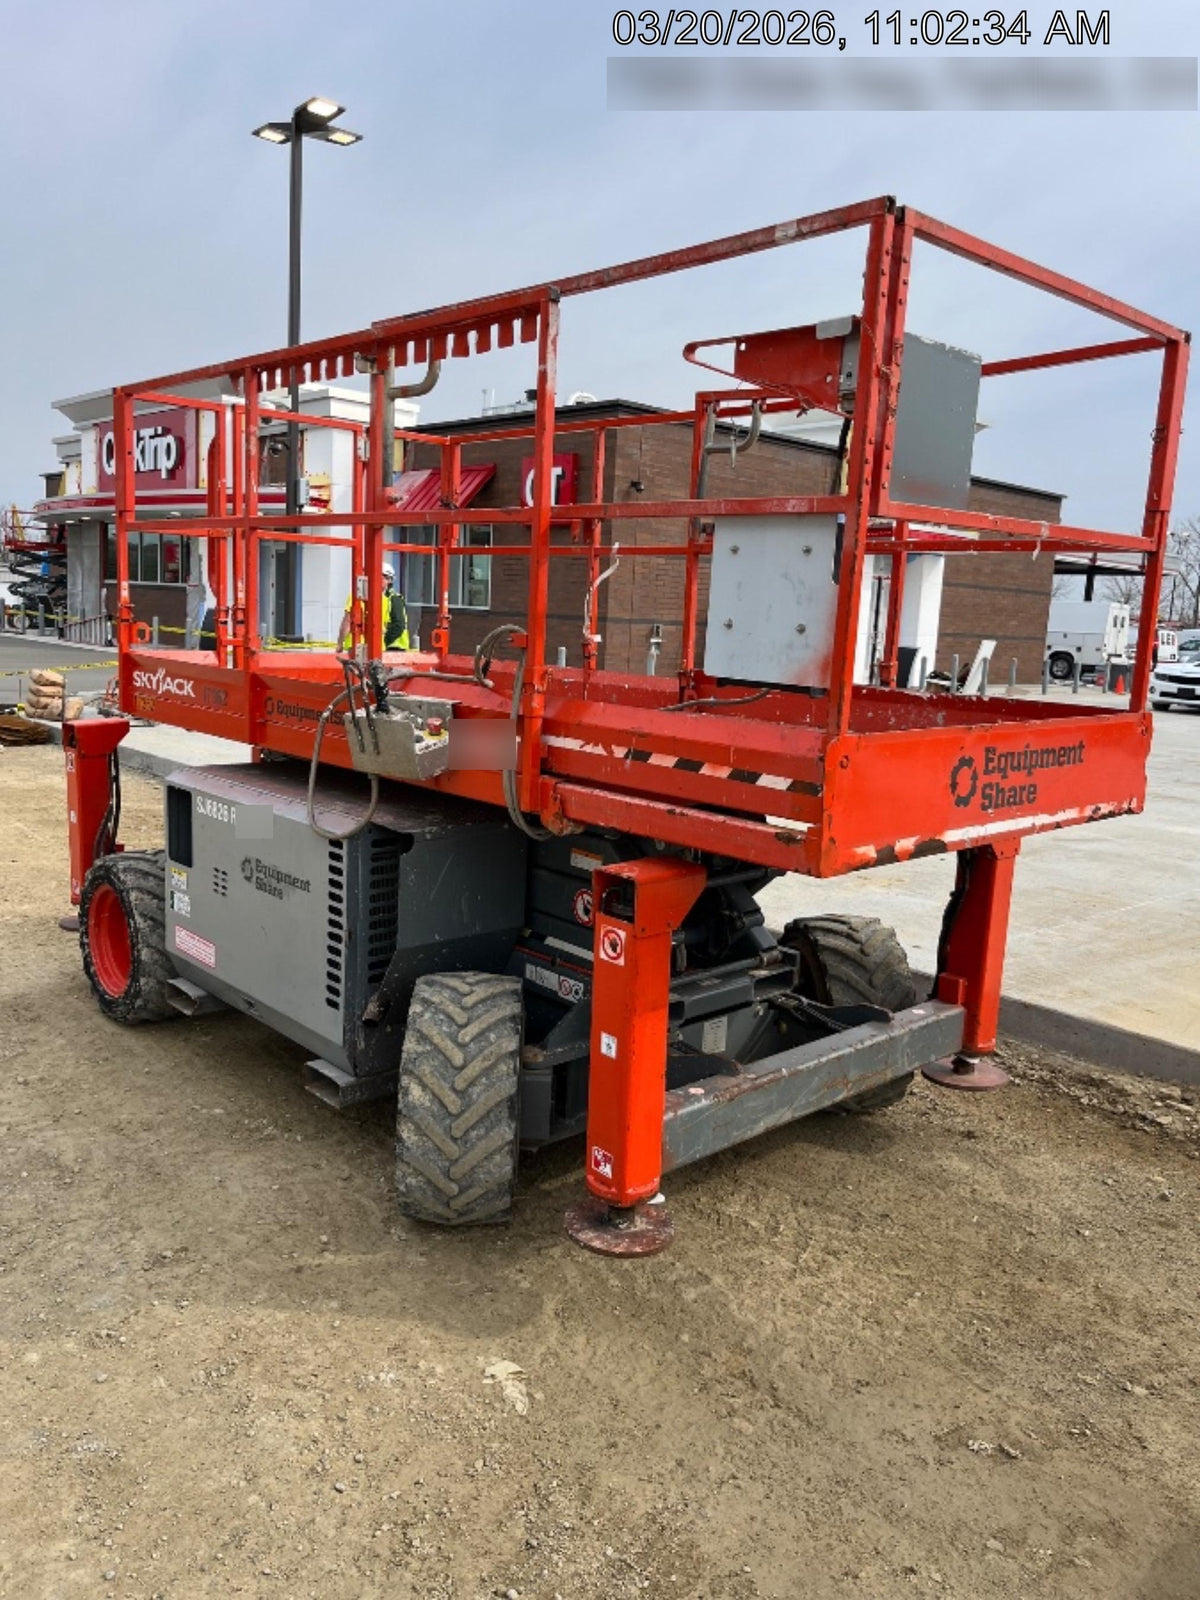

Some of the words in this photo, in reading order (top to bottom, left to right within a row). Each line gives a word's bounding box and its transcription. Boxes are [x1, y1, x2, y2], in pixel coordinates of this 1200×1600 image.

[102, 426, 177, 479] QkTrip
[133, 668, 196, 697] SKYJACK
[983, 740, 1085, 779] Equipment
[981, 782, 1037, 811] Share
[255, 858, 311, 893] Equipment
[255, 876, 283, 900] Share
